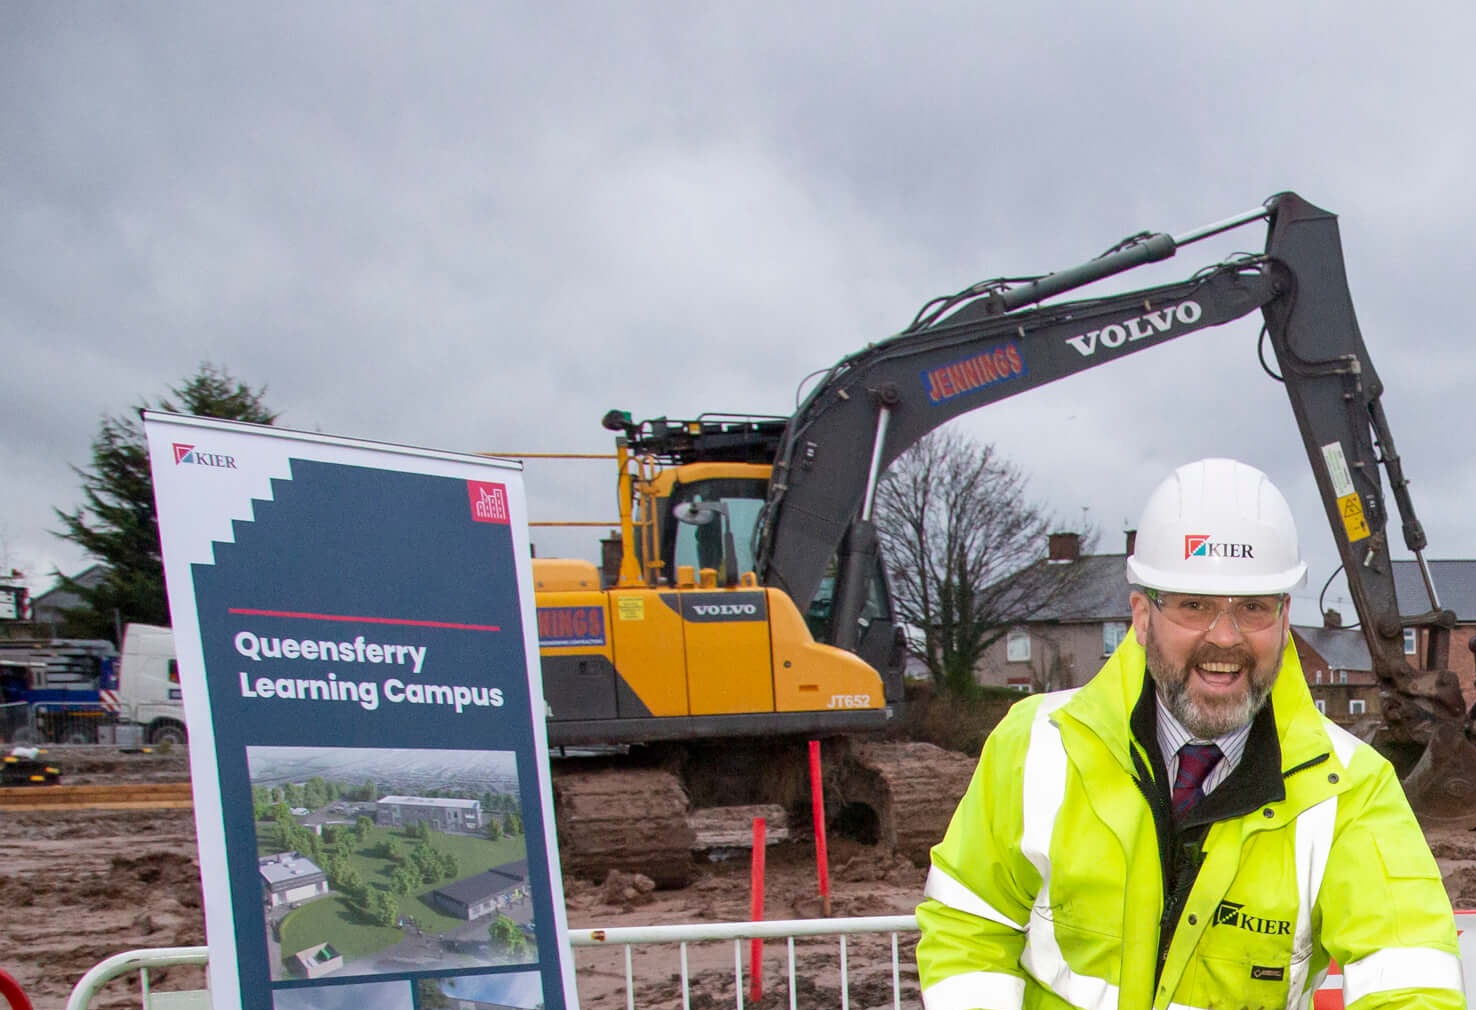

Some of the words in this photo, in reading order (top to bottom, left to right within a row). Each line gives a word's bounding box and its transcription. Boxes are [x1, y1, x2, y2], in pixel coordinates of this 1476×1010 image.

[1066, 301, 1202, 356] VOLVO
[929, 344, 1023, 401] JENNINGS
[196, 452, 239, 469] KIER
[1208, 543, 1254, 559] KIER
[692, 604, 757, 616] VOLVO
[234, 631, 427, 674] Queensferry
[239, 672, 379, 710] Learning
[383, 678, 505, 713] Campus
[826, 694, 871, 709] JT652
[1240, 913, 1291, 935] KIER
